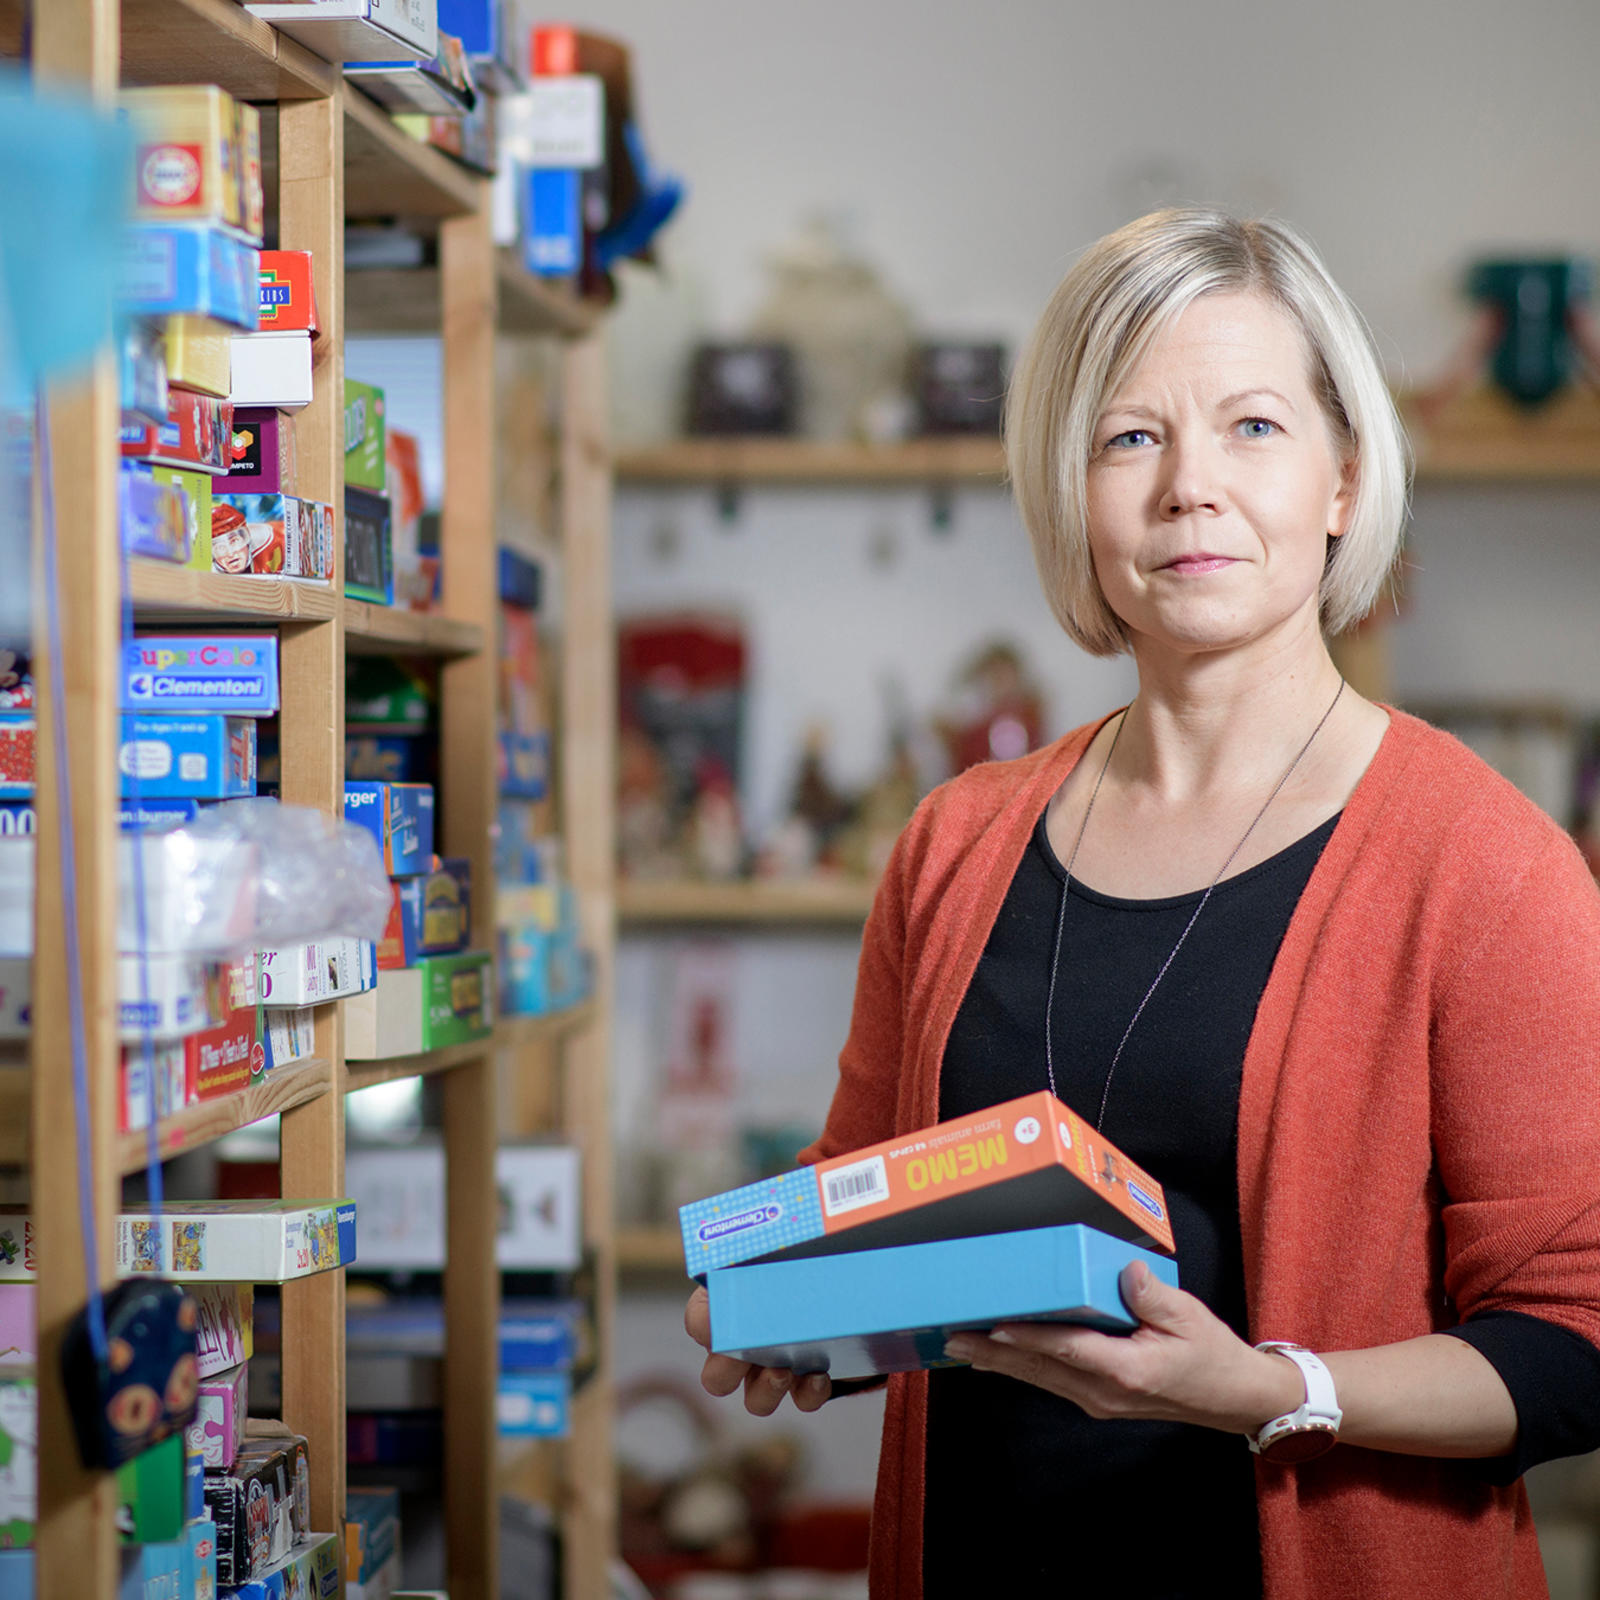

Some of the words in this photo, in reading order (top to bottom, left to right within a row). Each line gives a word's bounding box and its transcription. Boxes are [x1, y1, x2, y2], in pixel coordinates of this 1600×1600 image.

[153, 677, 262, 696] Clementoni
[974, 1117, 1002, 1134] farm
[1021, 1122, 1035, 1135] 3+
[927, 1127, 973, 1149] animals
[905, 1132, 1008, 1192] MEMO
[703, 1208, 765, 1240] Clementoni
